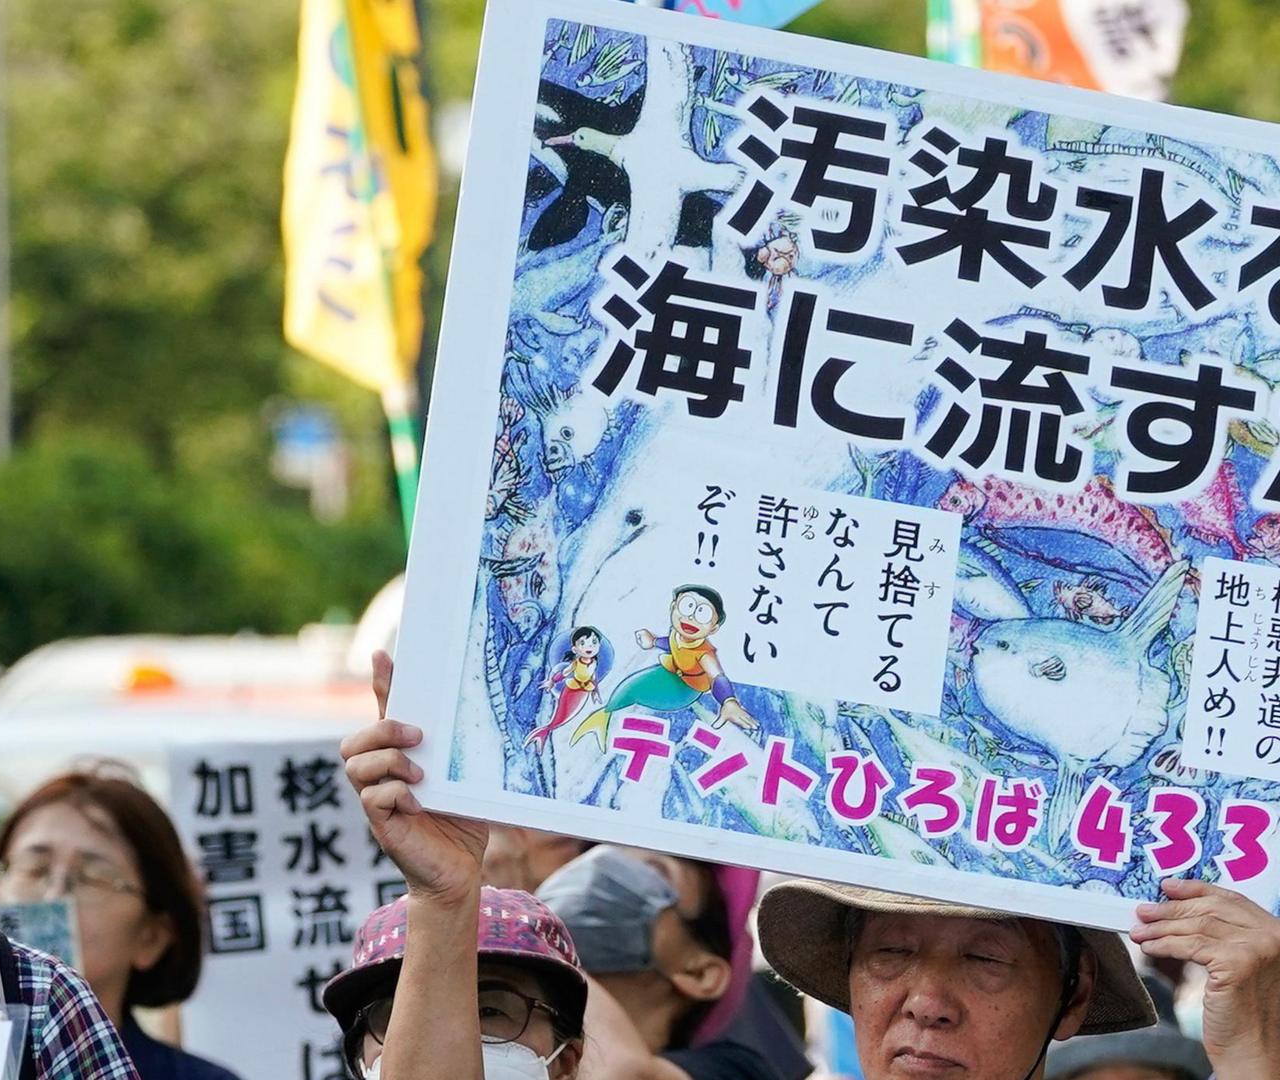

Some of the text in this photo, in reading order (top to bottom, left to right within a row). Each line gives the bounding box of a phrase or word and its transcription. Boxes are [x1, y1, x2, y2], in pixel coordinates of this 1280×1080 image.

[743, 494, 800, 664] 許さない
[813, 508, 860, 637] なんて
[872, 519, 926, 693] 見捨てる
[193, 760, 265, 953] 加害国
[611, 717, 1042, 847] テントひろば
